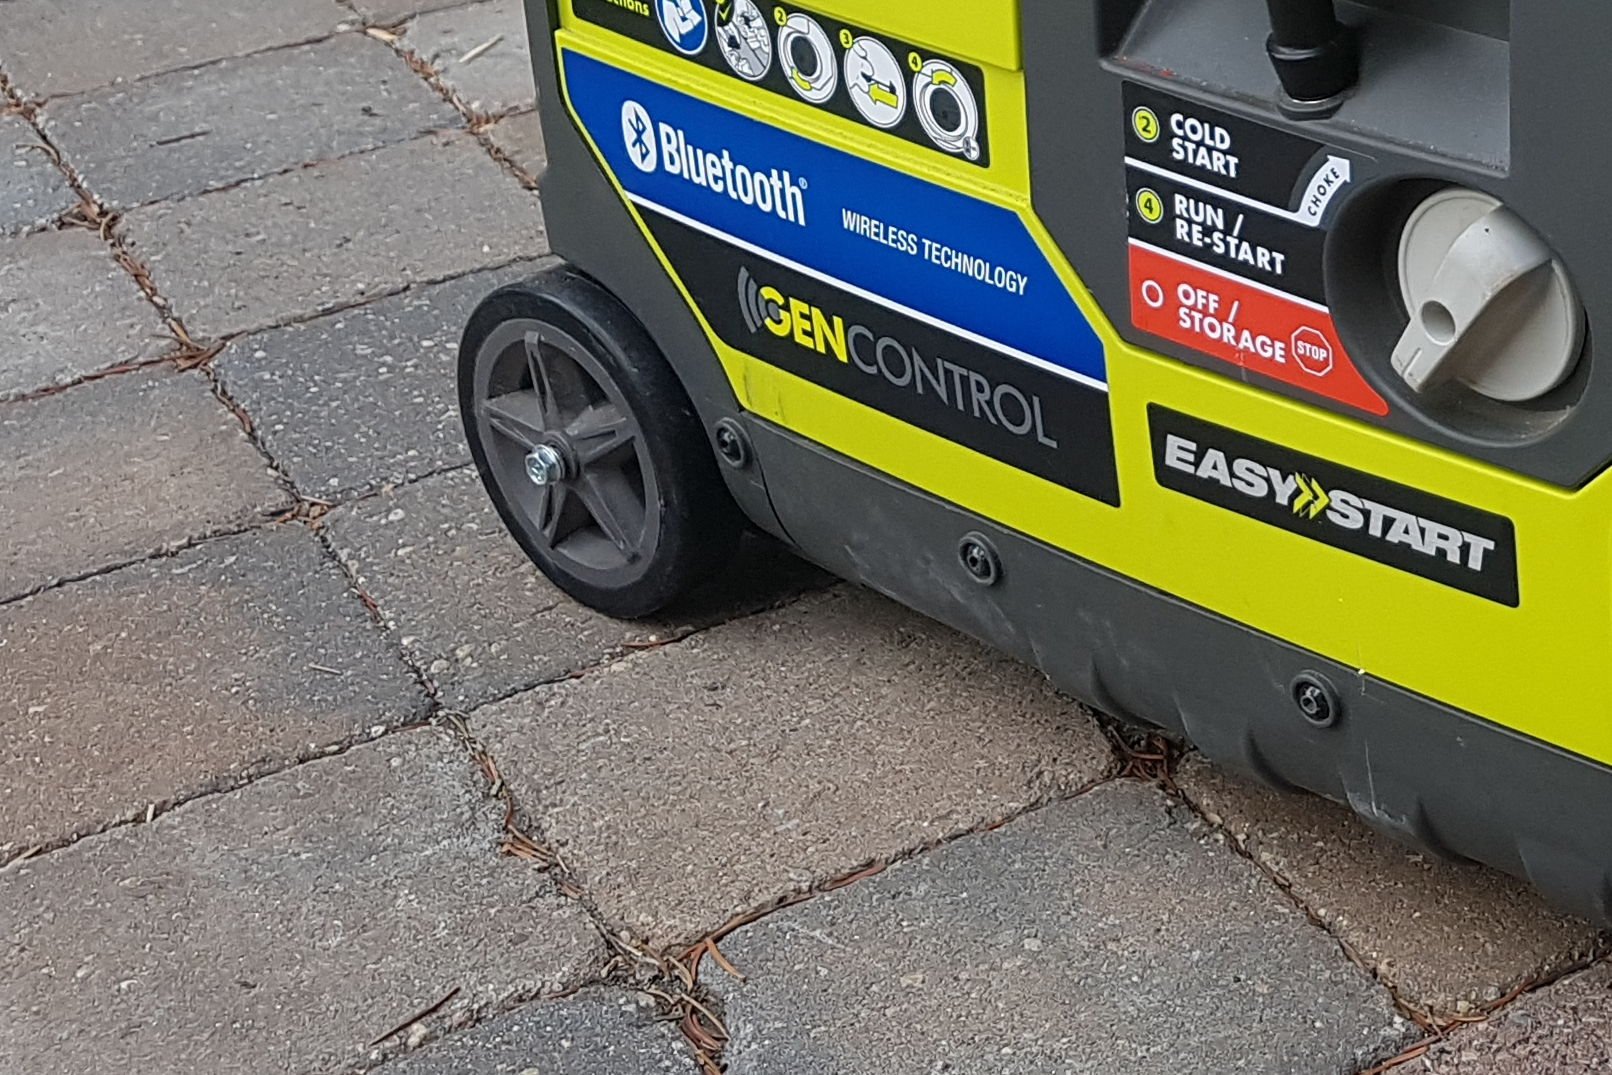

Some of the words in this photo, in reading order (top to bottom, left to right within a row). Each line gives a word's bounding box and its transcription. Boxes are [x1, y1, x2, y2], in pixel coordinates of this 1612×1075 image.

[1169, 112, 1231, 150] COLD
[1171, 137, 1240, 179] START
[1174, 192, 1225, 231] RUN
[1306, 166, 1341, 218] CHOKE
[841, 208, 919, 255] WIRELESS
[921, 238, 1028, 296] TECHNOLOGY
[1175, 219, 1286, 276] RE-START
[1177, 283, 1219, 316] OFF
[1178, 309, 1287, 365] STORAGE
[1296, 339, 1329, 362] STOP
[758, 284, 1058, 449] GENCONTROL
[1164, 433, 1298, 507] EASY
[1326, 491, 1496, 573] START
